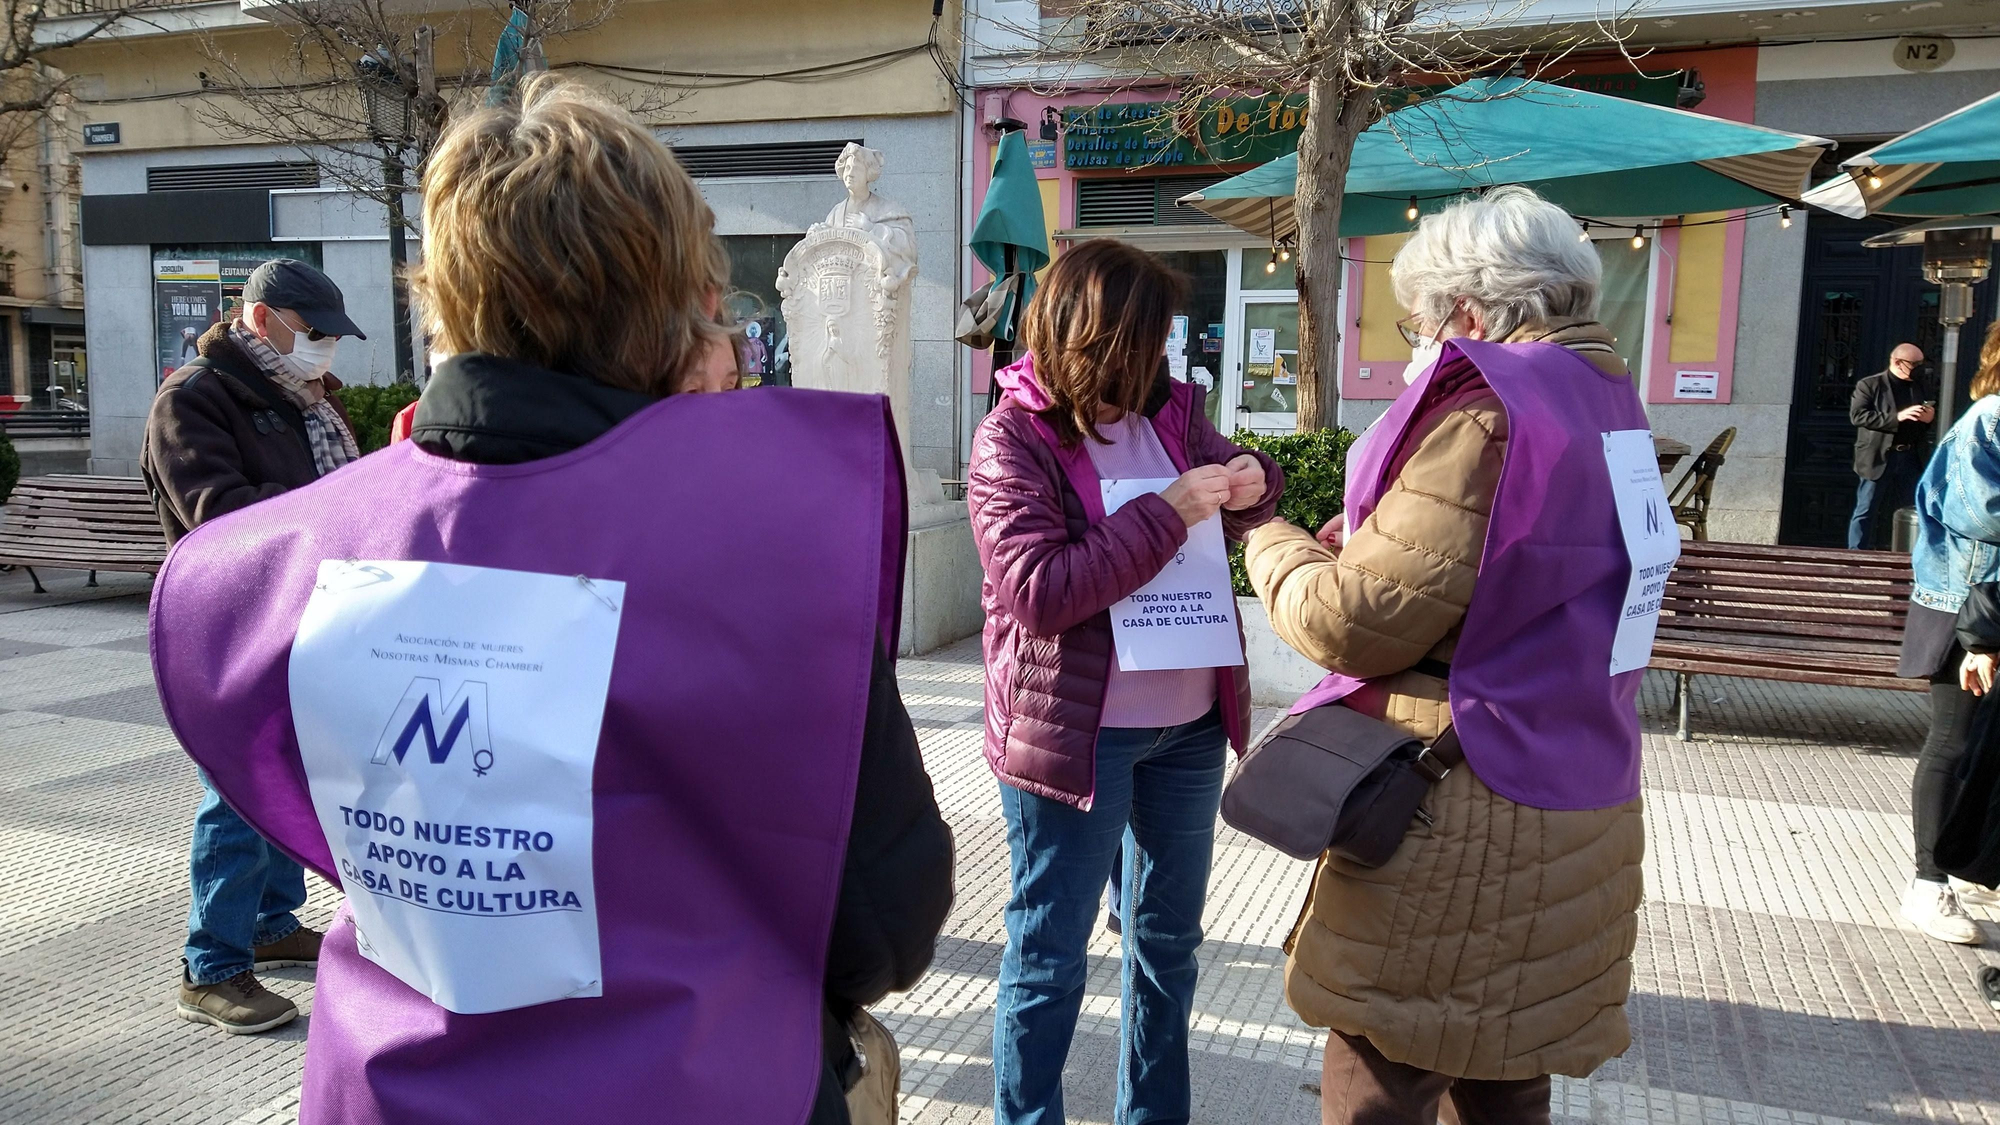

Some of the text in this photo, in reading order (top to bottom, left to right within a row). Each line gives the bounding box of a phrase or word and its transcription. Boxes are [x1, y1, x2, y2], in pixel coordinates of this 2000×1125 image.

[1098, 107, 1111, 120] de
[1216, 105, 1250, 134] De
[1067, 137, 1118, 151] Detalles
[1125, 137, 1138, 150] de
[1067, 153, 1109, 167] Bolsas
[1116, 151, 1131, 164] de
[1140, 148, 1184, 165] cumple
[171, 295, 207, 304] HERE COMES
[171, 303, 207, 316] YOUR MAN
[1639, 566, 1655, 581] TODO
[1641, 581, 1661, 597] APOYO
[1129, 591, 1212, 603] TODO NUESTRO
[1142, 603, 1204, 614] APOYO A LA
[1626, 603, 1646, 617] CASA
[1646, 600, 1656, 612] DE
[1122, 614, 1229, 628] CASA DE CULTURA
[339, 805, 554, 853] TODO NUESTRO
[366, 841, 526, 882] APOYO A LA
[341, 858, 582, 913] CASA DE CULTURA
